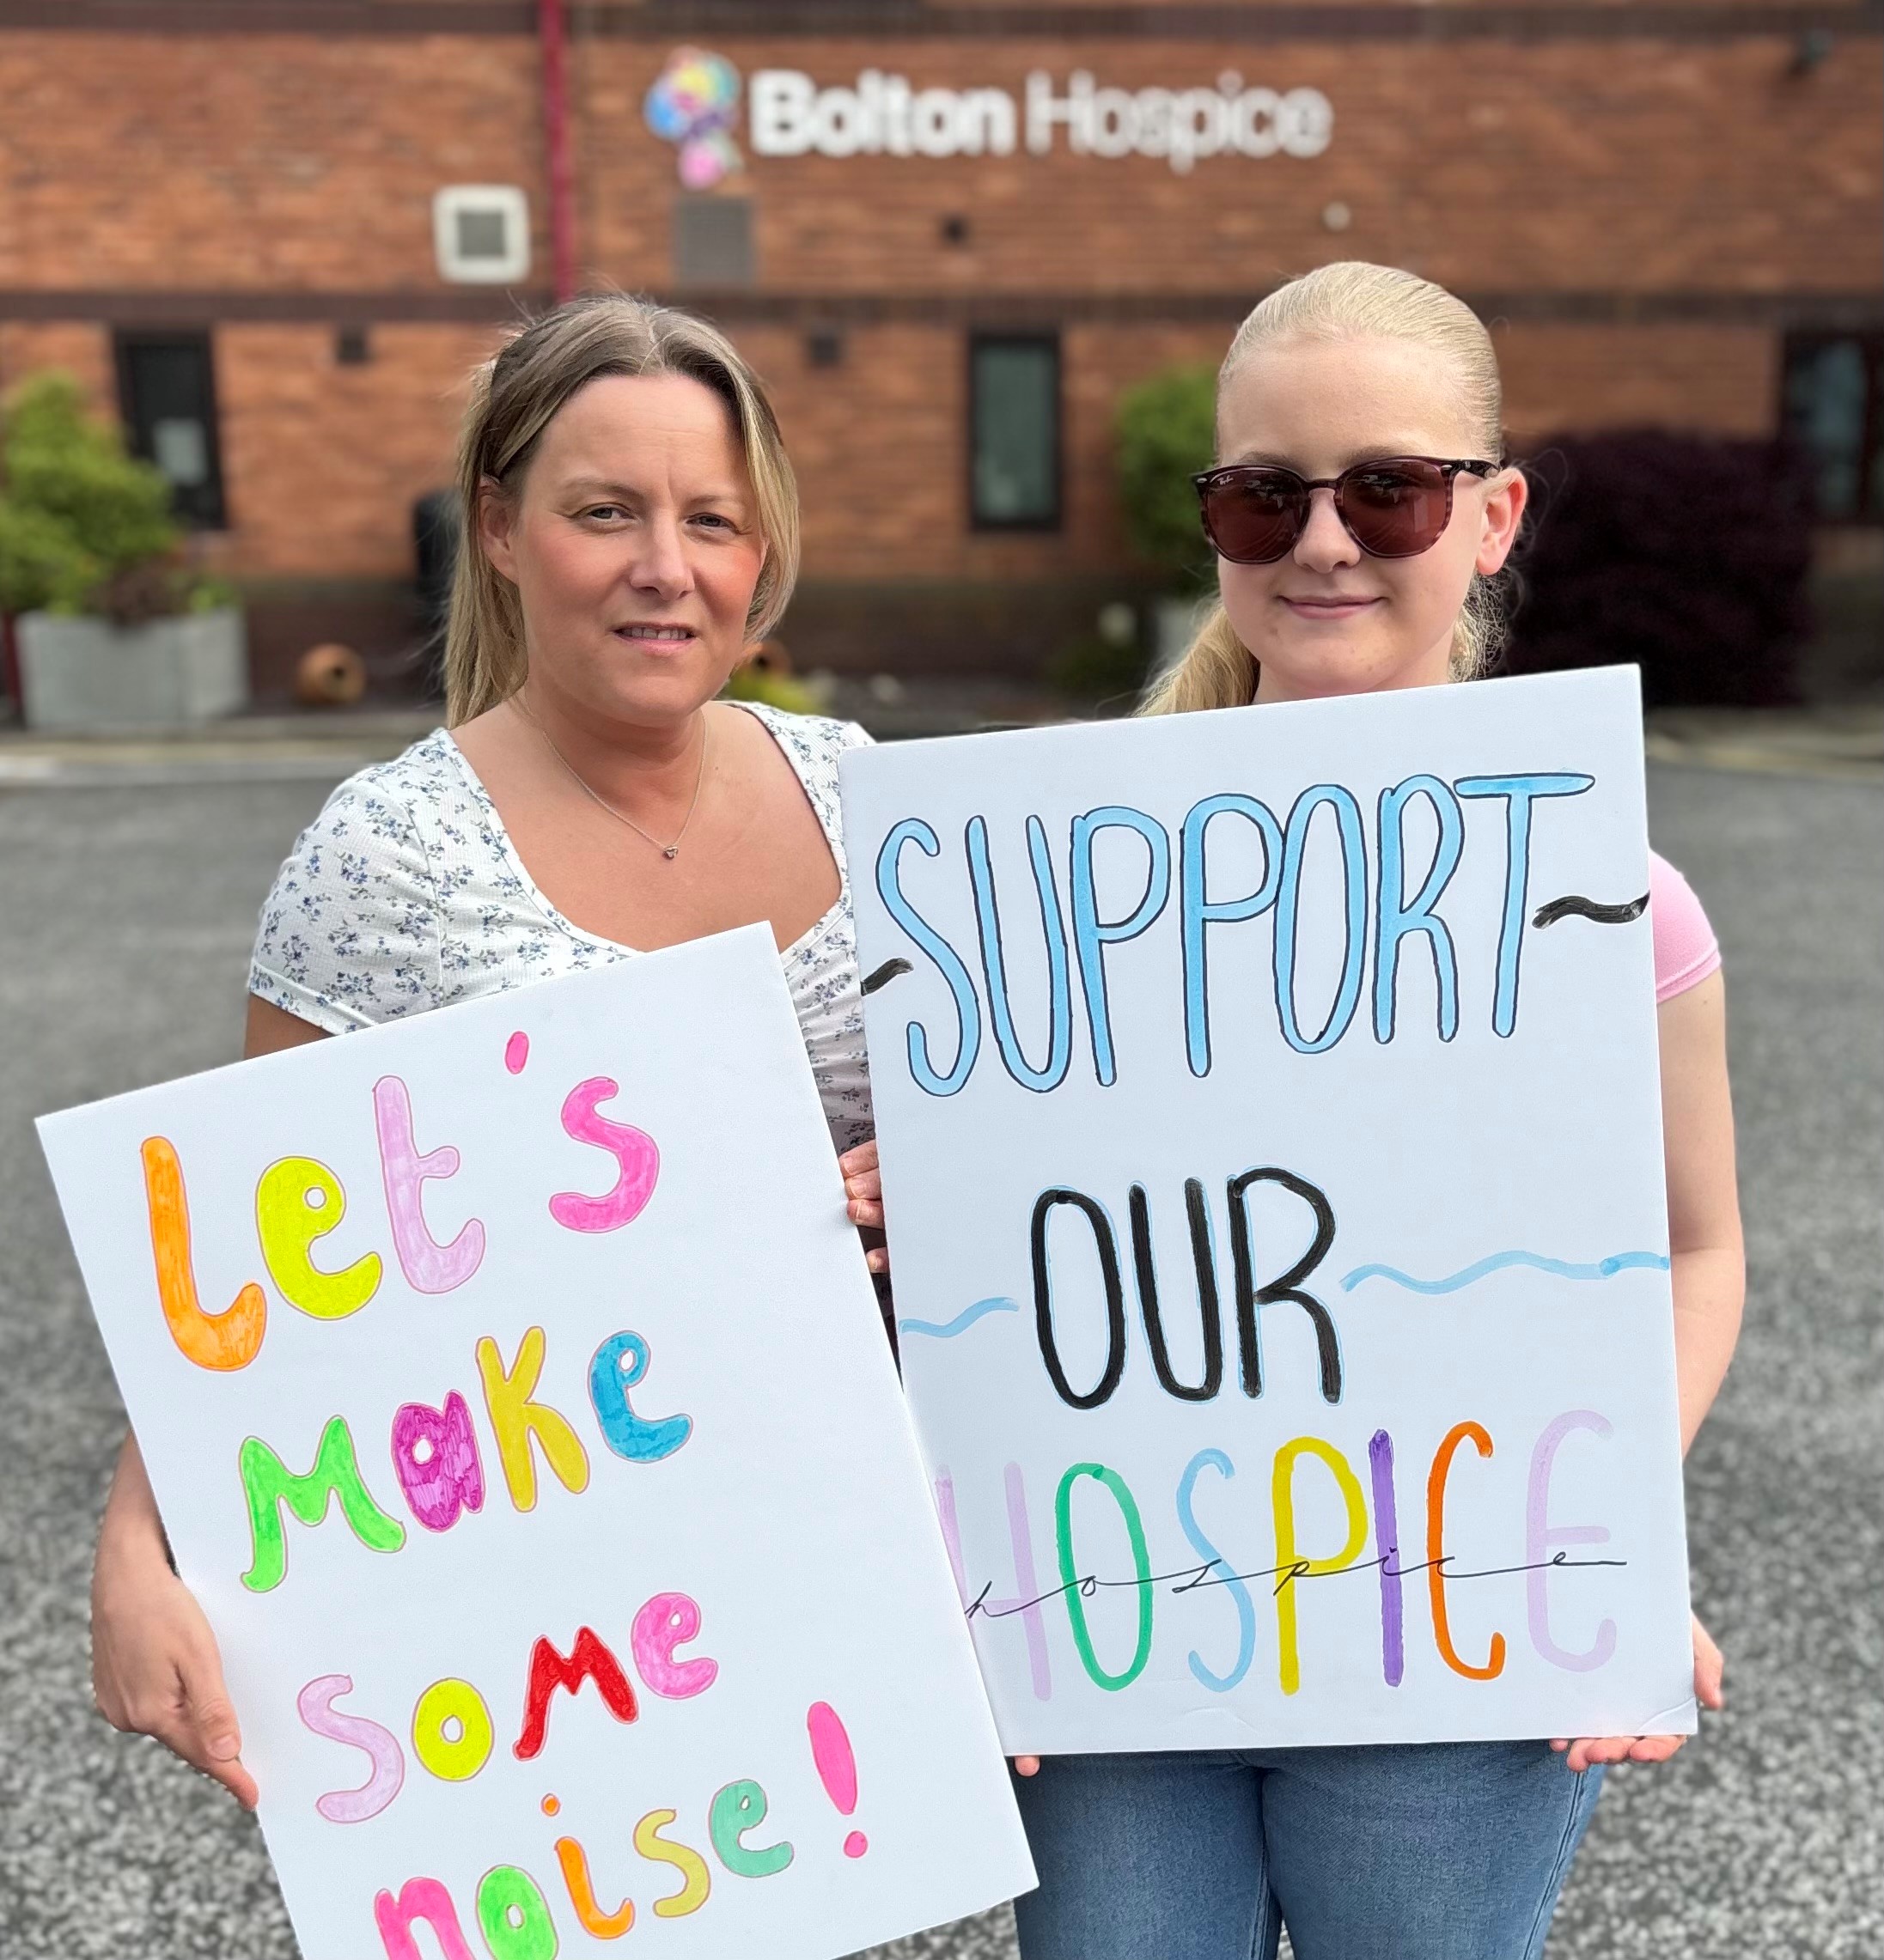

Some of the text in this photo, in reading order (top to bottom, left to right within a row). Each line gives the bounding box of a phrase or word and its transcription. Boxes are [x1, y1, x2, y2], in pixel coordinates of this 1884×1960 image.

[748, 69, 1334, 173] Bolton Hospice
[875, 774, 1596, 1097] SUPPORT
[140, 1031, 661, 1372] Let's
[1030, 1166, 1343, 1409] OUR
[935, 1409, 1618, 1701] HOSPICE
[964, 1548, 1626, 1618] hospice
